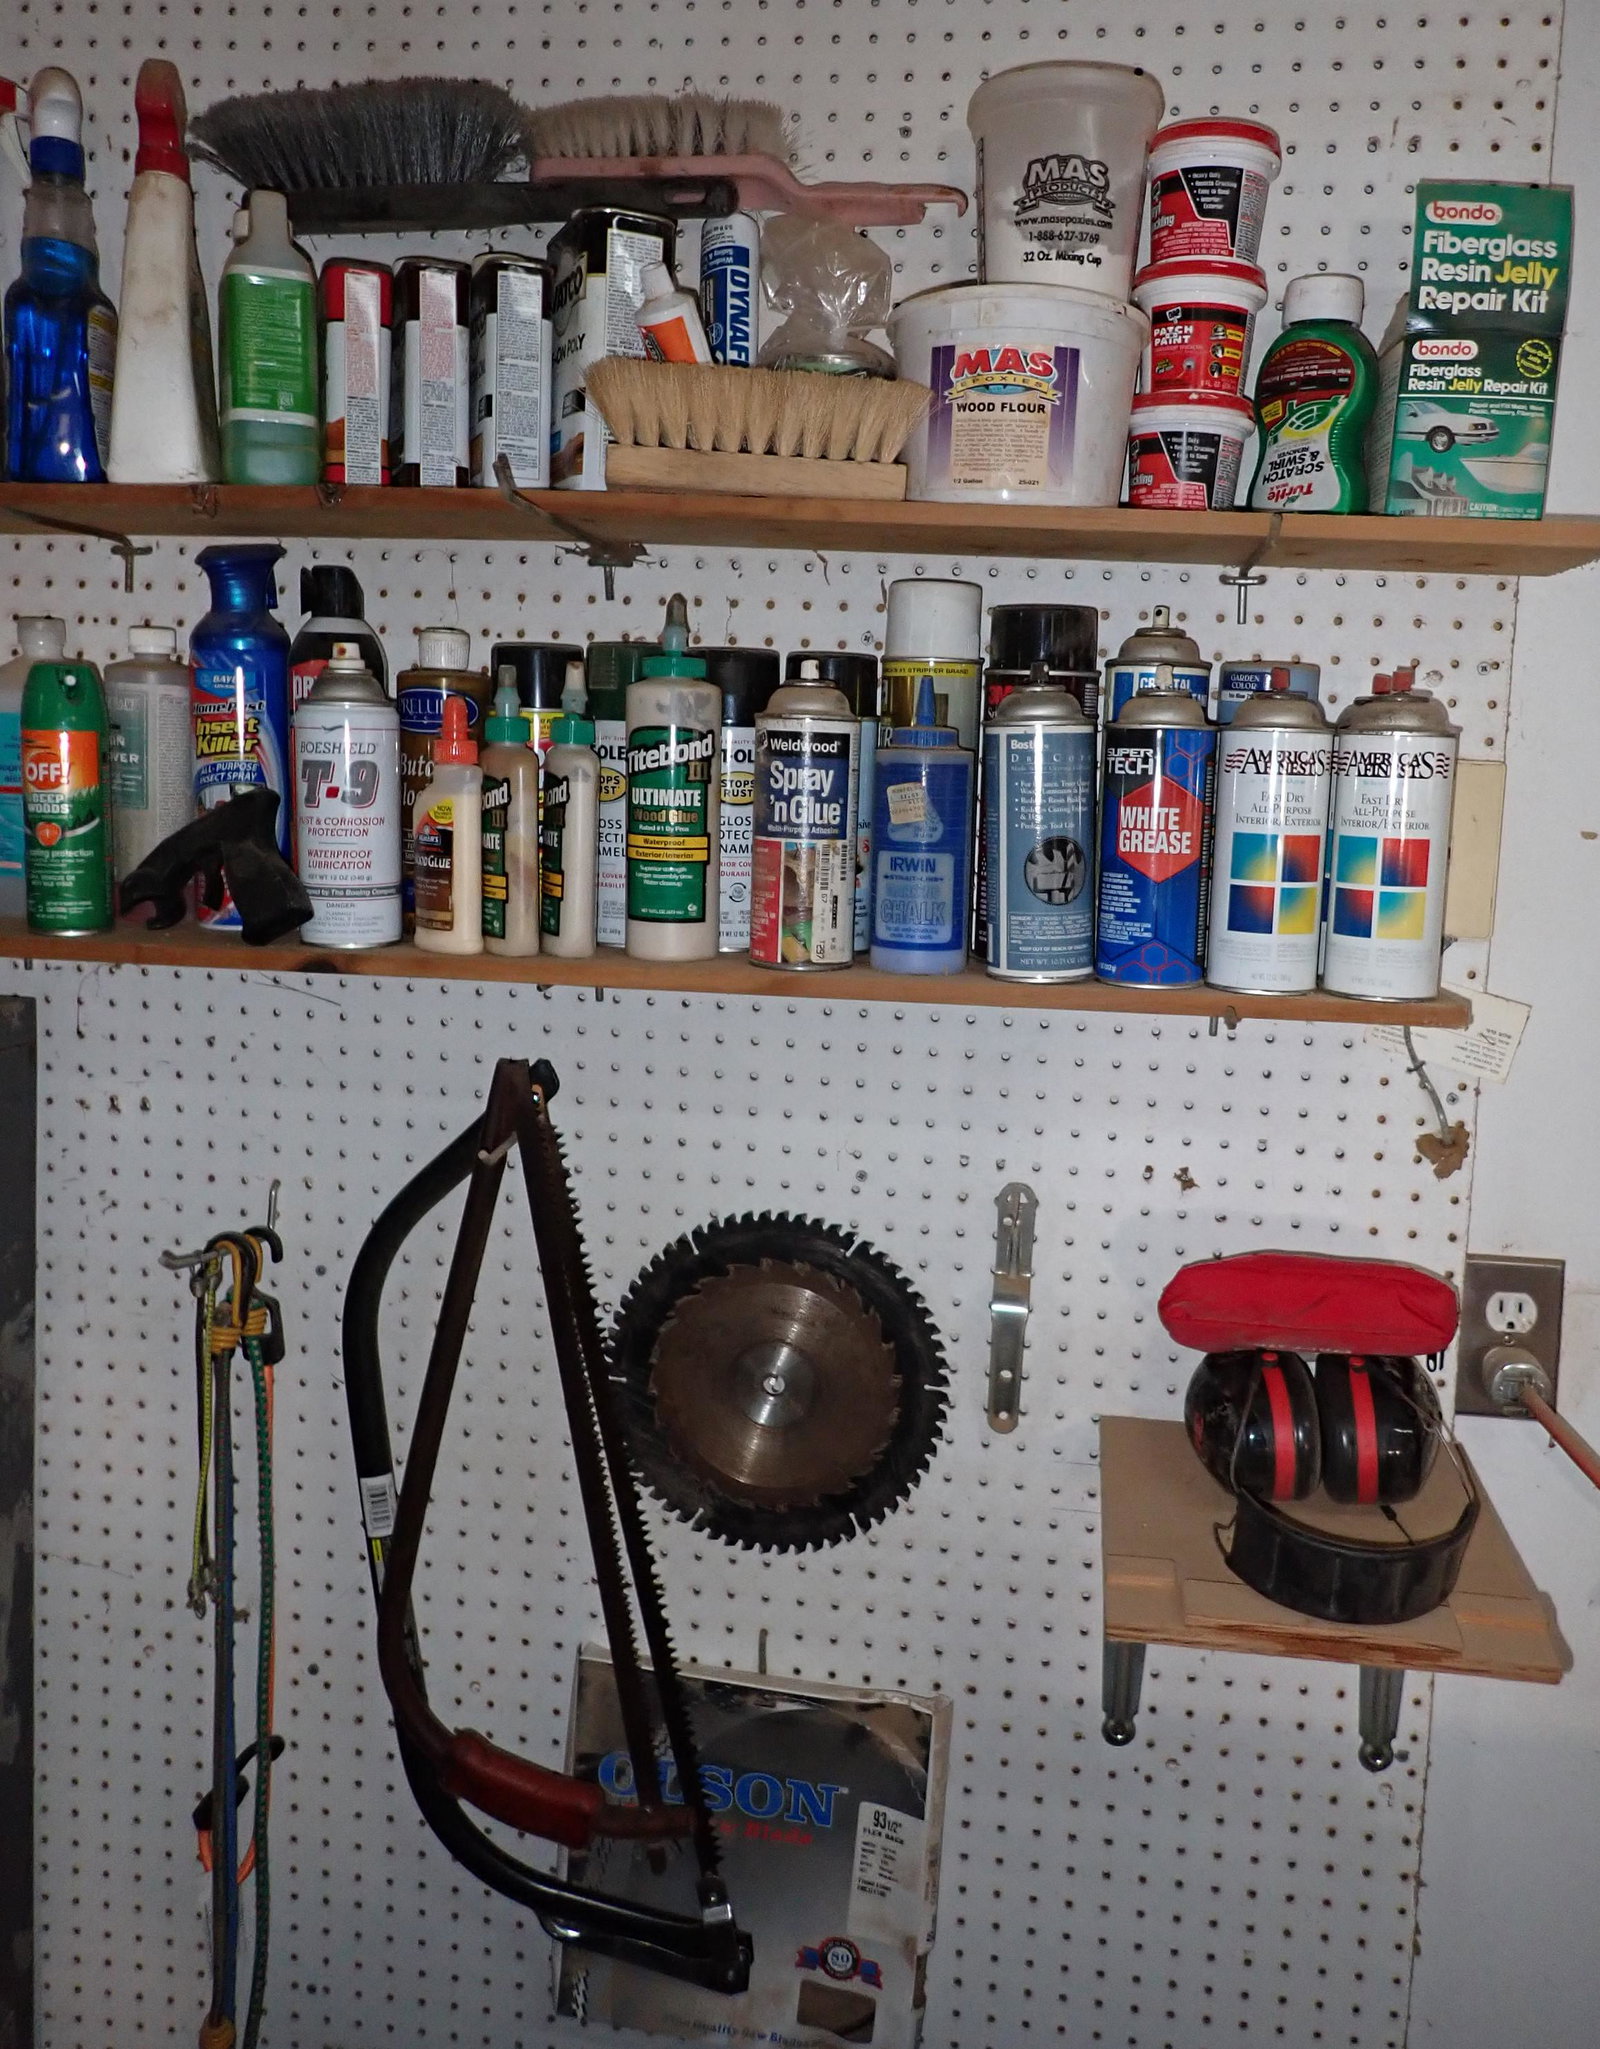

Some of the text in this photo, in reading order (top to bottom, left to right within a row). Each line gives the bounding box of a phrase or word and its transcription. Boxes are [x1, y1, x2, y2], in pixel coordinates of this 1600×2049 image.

[1027, 158, 1106, 188] MAS
[1433, 201, 1496, 220] bondo
[1014, 214, 1113, 229] www.masepoxies.com
[1029, 231, 1100, 244] 1-888-627-3769
[1423, 230, 1558, 262] Fiberglass
[1023, 252, 1035, 262] 32
[1055, 250, 1085, 265] Mixing
[1087, 253, 1102, 267] Cup
[1421, 258, 1559, 290] Resin Jelly
[1418, 286, 1549, 315] Repair Kit
[1153, 325, 1194, 337] PATCH
[1154, 335, 1191, 347] PAINT
[1418, 339, 1472, 356] bondo
[953, 347, 1054, 379] MAS
[1409, 364, 1482, 379] Fiberglass
[959, 377, 1044, 388] EPOXIES
[1408, 379, 1549, 395] Resin Jelly Repair Kit
[956, 402, 1046, 414] WOOD FLOUR
[1268, 450, 1320, 472] & SWIRL
[1262, 460, 1325, 485] SCRATCH
[1267, 482, 1314, 501] Turtle
[1140, 677, 1191, 690] CRTAL
[1230, 674, 1260, 683] GARDEN
[1231, 682, 1257, 690] COLOR
[300, 741, 377, 755] BOESHELD
[627, 733, 714, 774] Titebond
[770, 738, 838, 753] Weldwood
[1107, 747, 1154, 758] SUPER
[25, 761, 71, 785] OFF!
[688, 761, 711, 782] III
[1107, 757, 1154, 776] TECH
[227, 770, 258, 782] SPRAY
[769, 760, 835, 797] Spray
[631, 787, 702, 807] ULTIMATE
[1286, 791, 1305, 803] DRY
[1361, 793, 1382, 805] FAST
[634, 809, 699, 825] Wood Glue
[789, 795, 841, 825] Glue
[323, 816, 385, 827] CORROSION
[1120, 806, 1181, 831] WHITE
[307, 828, 369, 837] PROTECTION
[643, 838, 686, 847] Waterproof
[1119, 830, 1193, 855] GREASE
[307, 849, 374, 859] WATERPROOF
[635, 849, 694, 860] Exterior/Interior
[308, 861, 372, 870] LUBRICATION
[890, 856, 936, 873] IRWIN
[345, 889, 371, 897] Boeing
[880, 898, 946, 926] CHALK
[873, 1809, 887, 1830] 93
